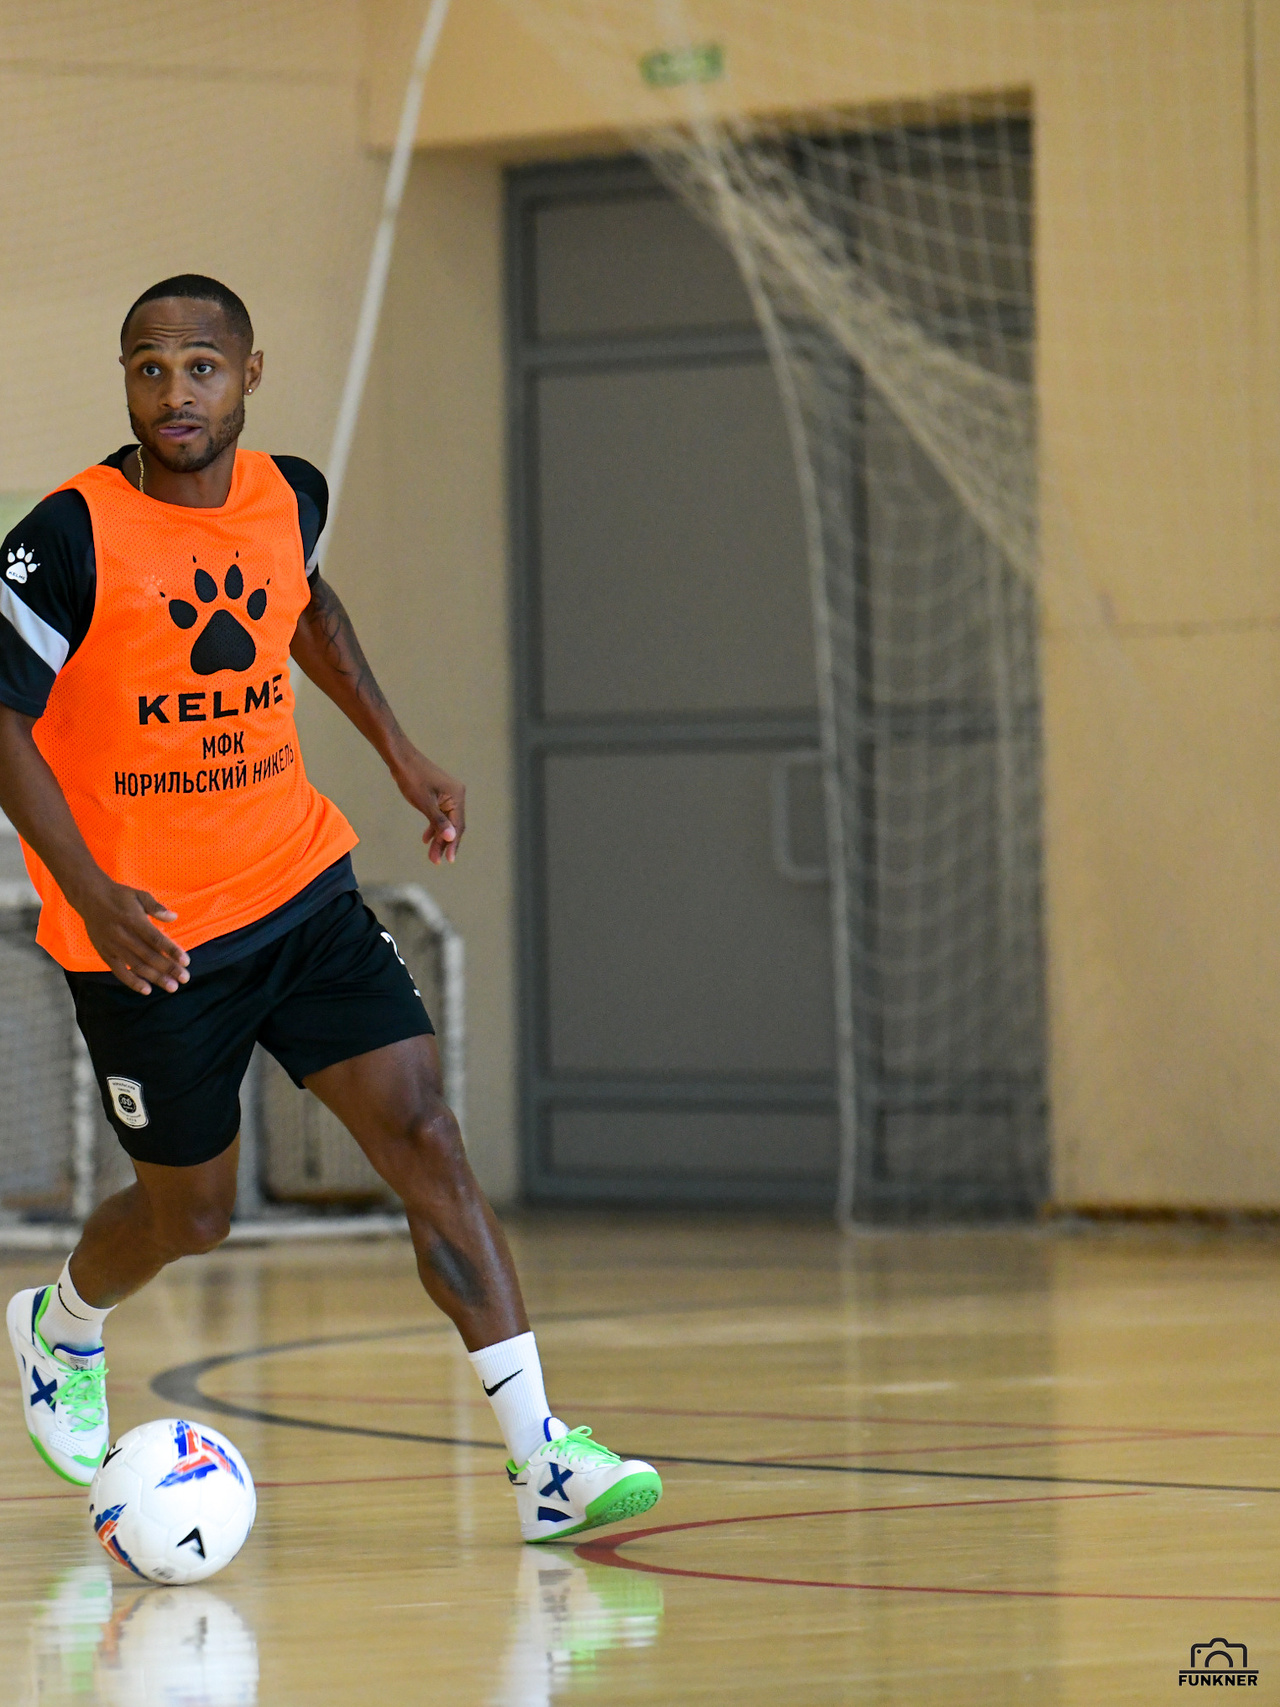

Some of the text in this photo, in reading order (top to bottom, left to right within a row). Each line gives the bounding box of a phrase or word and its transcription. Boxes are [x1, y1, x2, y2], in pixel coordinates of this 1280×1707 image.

[138, 673, 283, 726] KELME
[114, 742, 294, 797] НОРИЛЬСКИЙ НИКЕЛЬ
[202, 731, 245, 760] МФК
